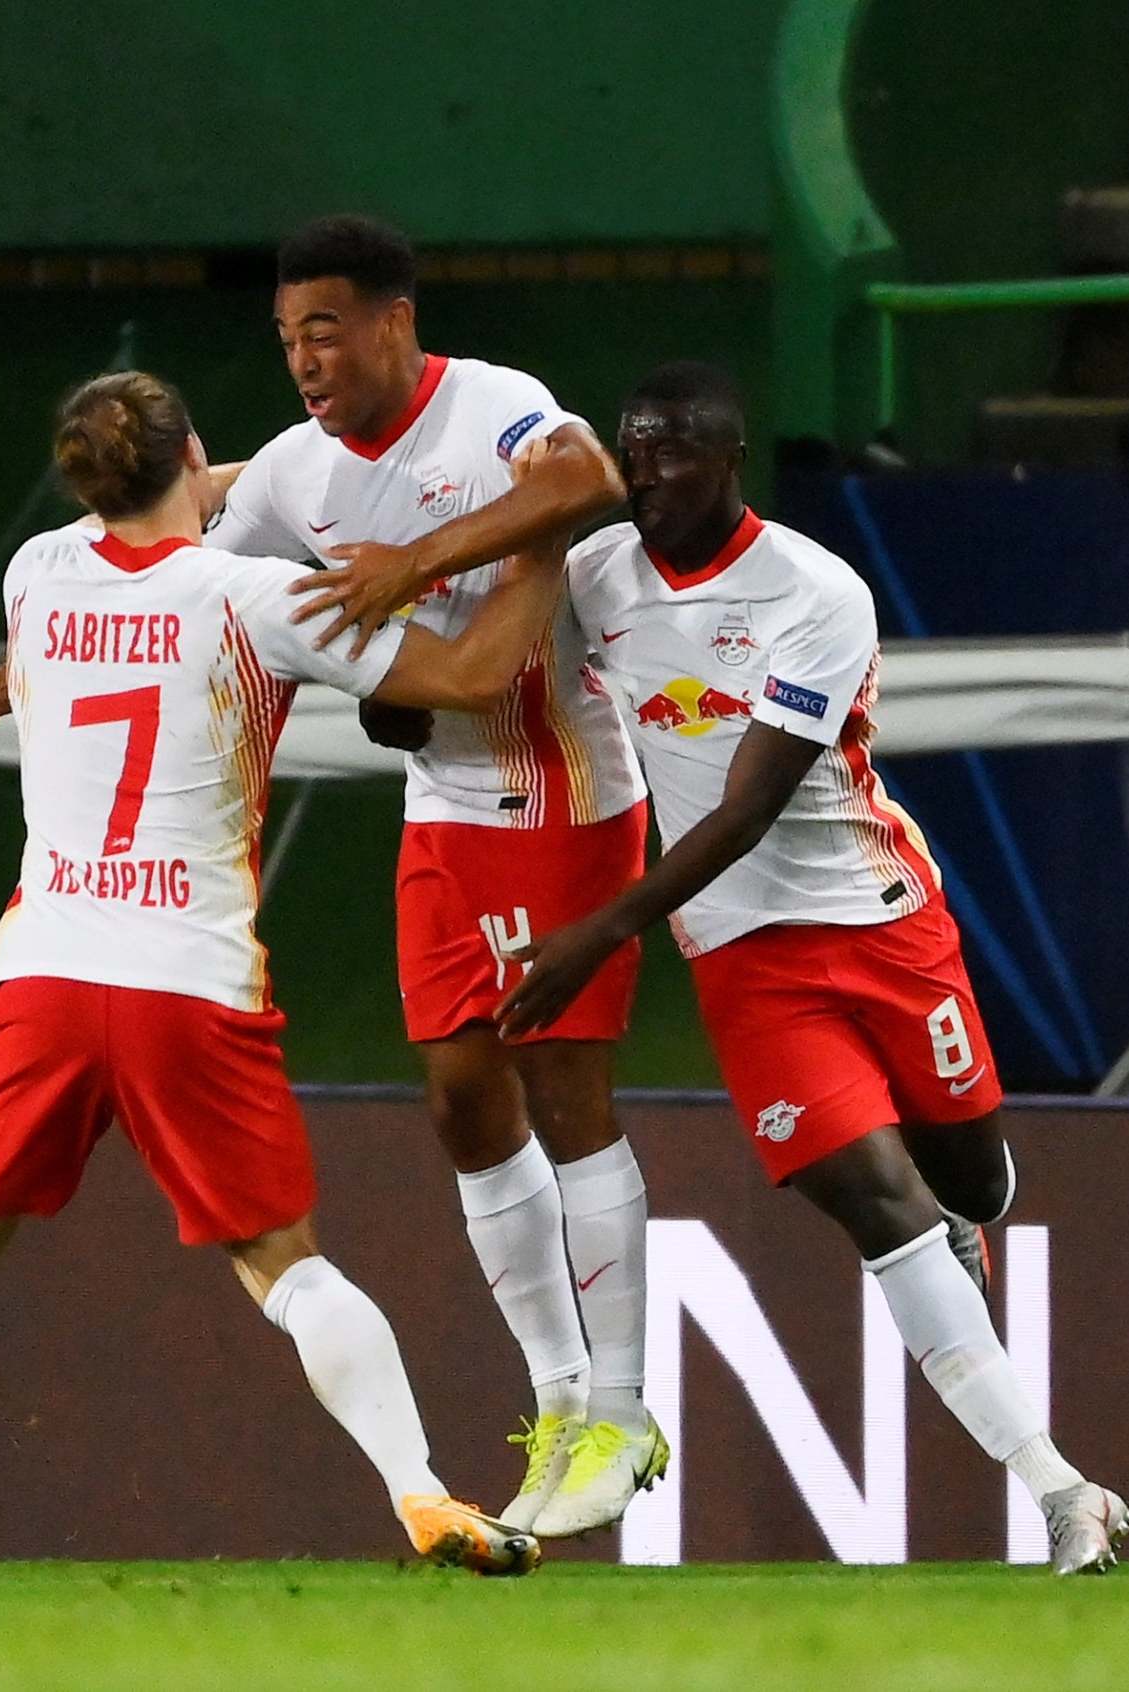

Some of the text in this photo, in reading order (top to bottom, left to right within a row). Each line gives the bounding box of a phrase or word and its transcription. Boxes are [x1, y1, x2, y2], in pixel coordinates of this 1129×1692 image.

[44, 610, 182, 663] SABITZER
[775, 686, 825, 712] RESPECT
[69, 685, 161, 857] 7
[84, 858, 191, 909] LEIPZIG
[926, 994, 974, 1079] 8
